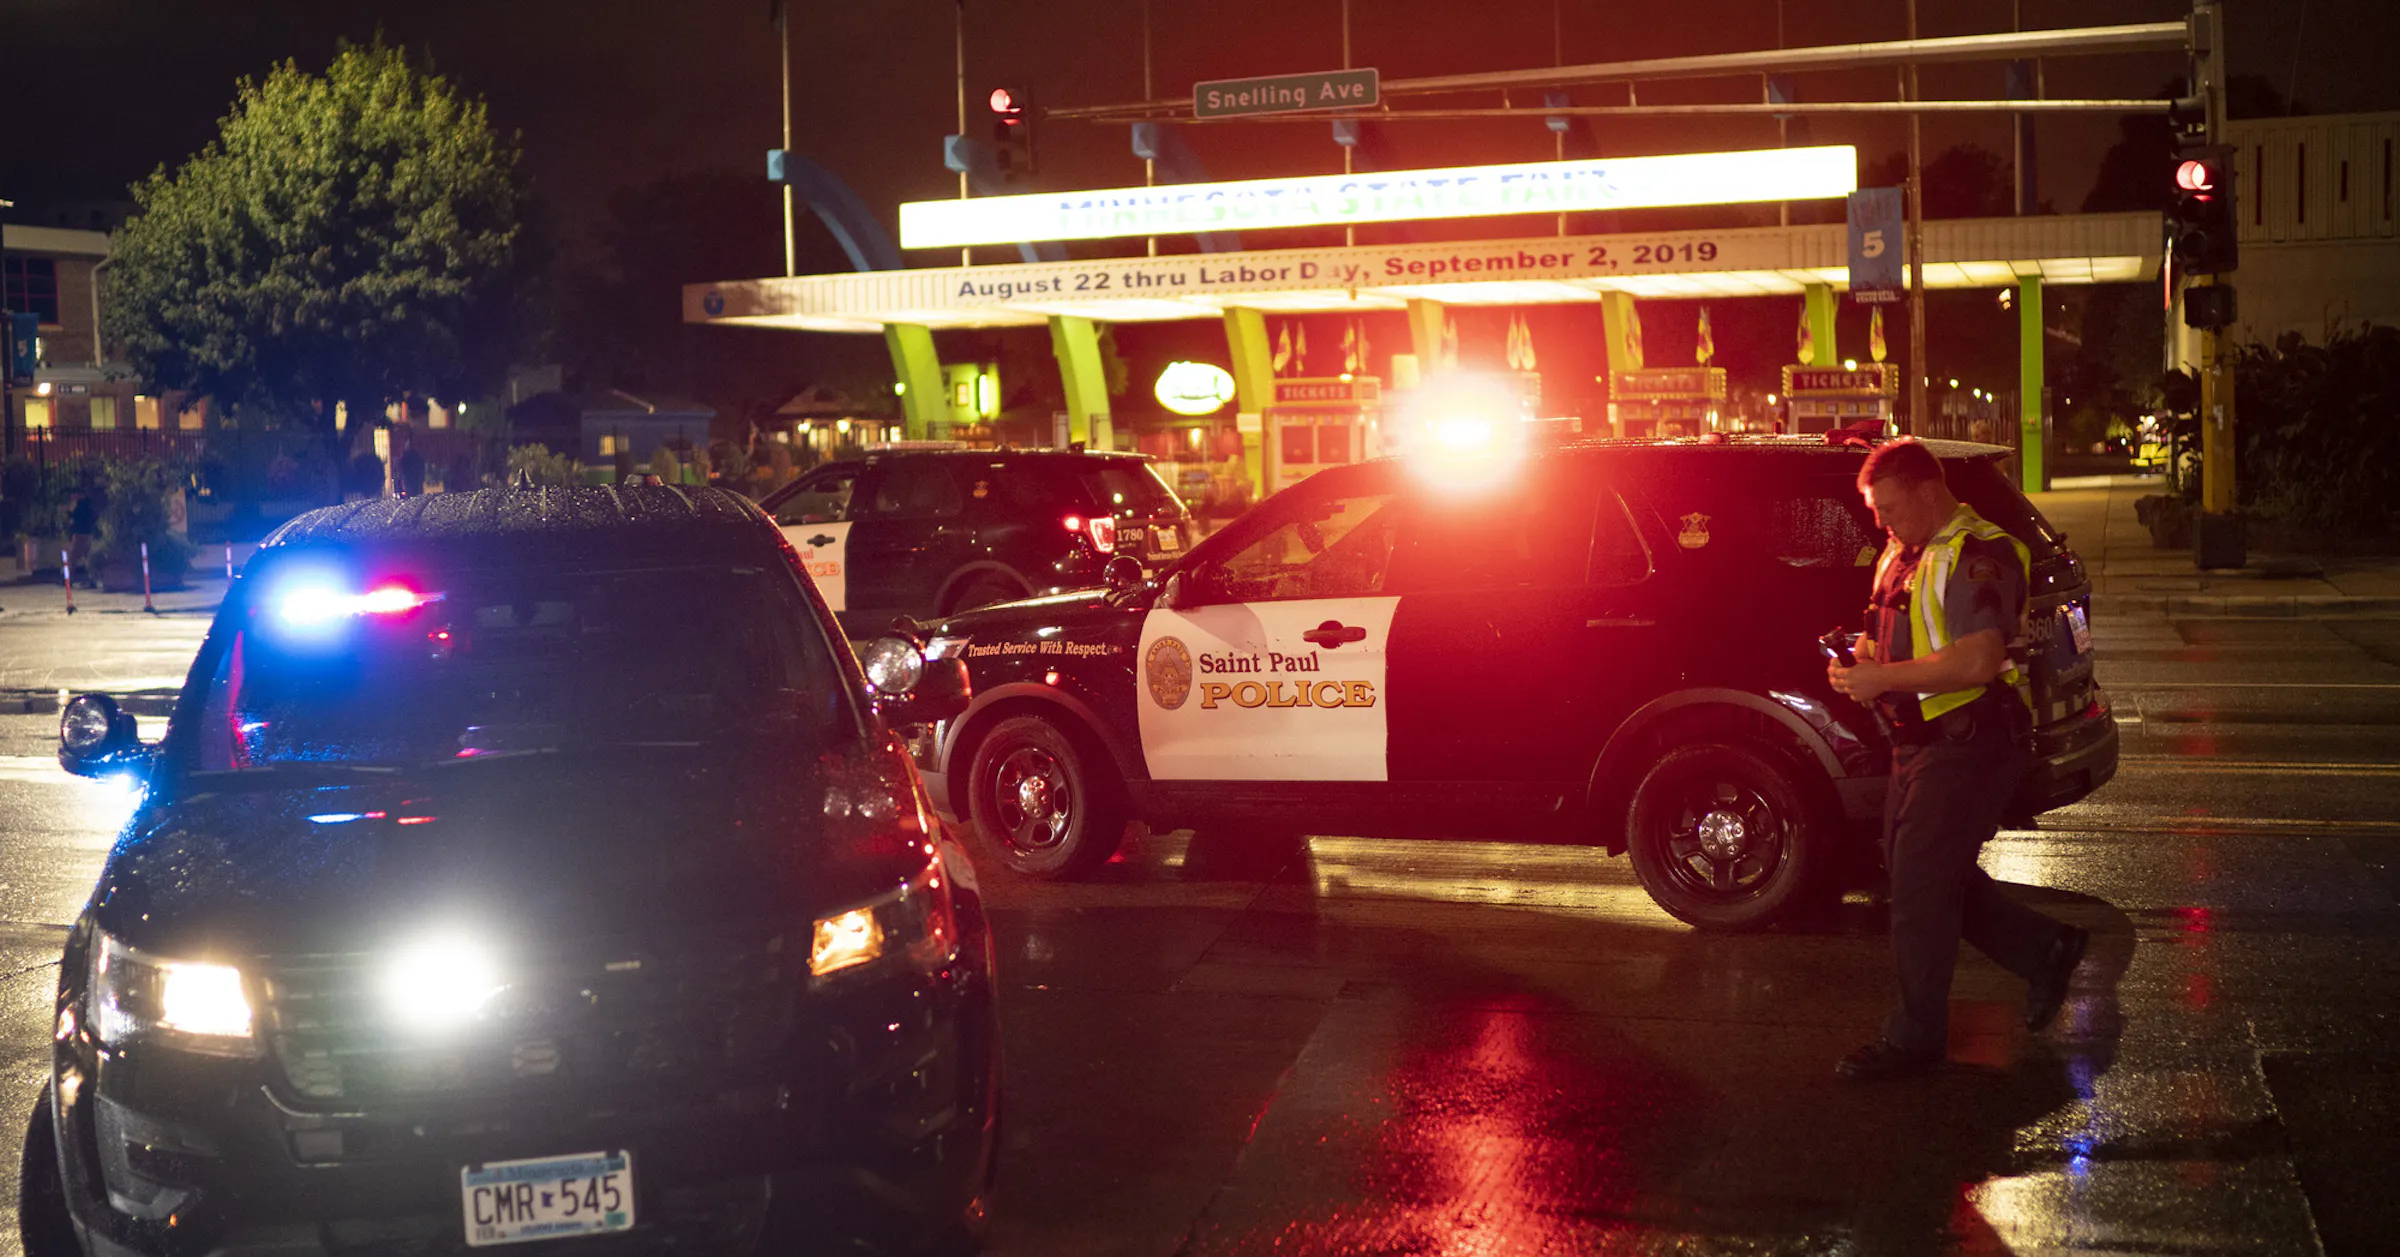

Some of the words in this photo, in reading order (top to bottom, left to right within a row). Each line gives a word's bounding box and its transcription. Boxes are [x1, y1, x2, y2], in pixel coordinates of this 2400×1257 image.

[1207, 86, 1305, 109] Snelling
[1319, 81, 1365, 100] Ave
[1862, 229, 1885, 258] 5
[958, 277, 1062, 300] August
[1075, 272, 1111, 291] 22
[1124, 269, 1187, 288] thru
[1200, 264, 1291, 284] Labor
[1384, 250, 1575, 278] September
[1588, 246, 1618, 269] 2,
[1633, 241, 1718, 265] 2019
[1283, 386, 1347, 400] TICKETS
[1801, 373, 1875, 389] TICKETS
[1116, 528, 1144, 541] 1780
[799, 547, 815, 560] aul
[967, 642, 1001, 658] Trusted
[1001, 641, 1037, 655] Service
[1039, 640, 1063, 654] With
[1199, 651, 1262, 674] Saint
[1268, 650, 1321, 673] Paul
[1200, 680, 1377, 709] POLICE
[473, 1183, 535, 1226] CMR
[561, 1175, 621, 1216] 545
